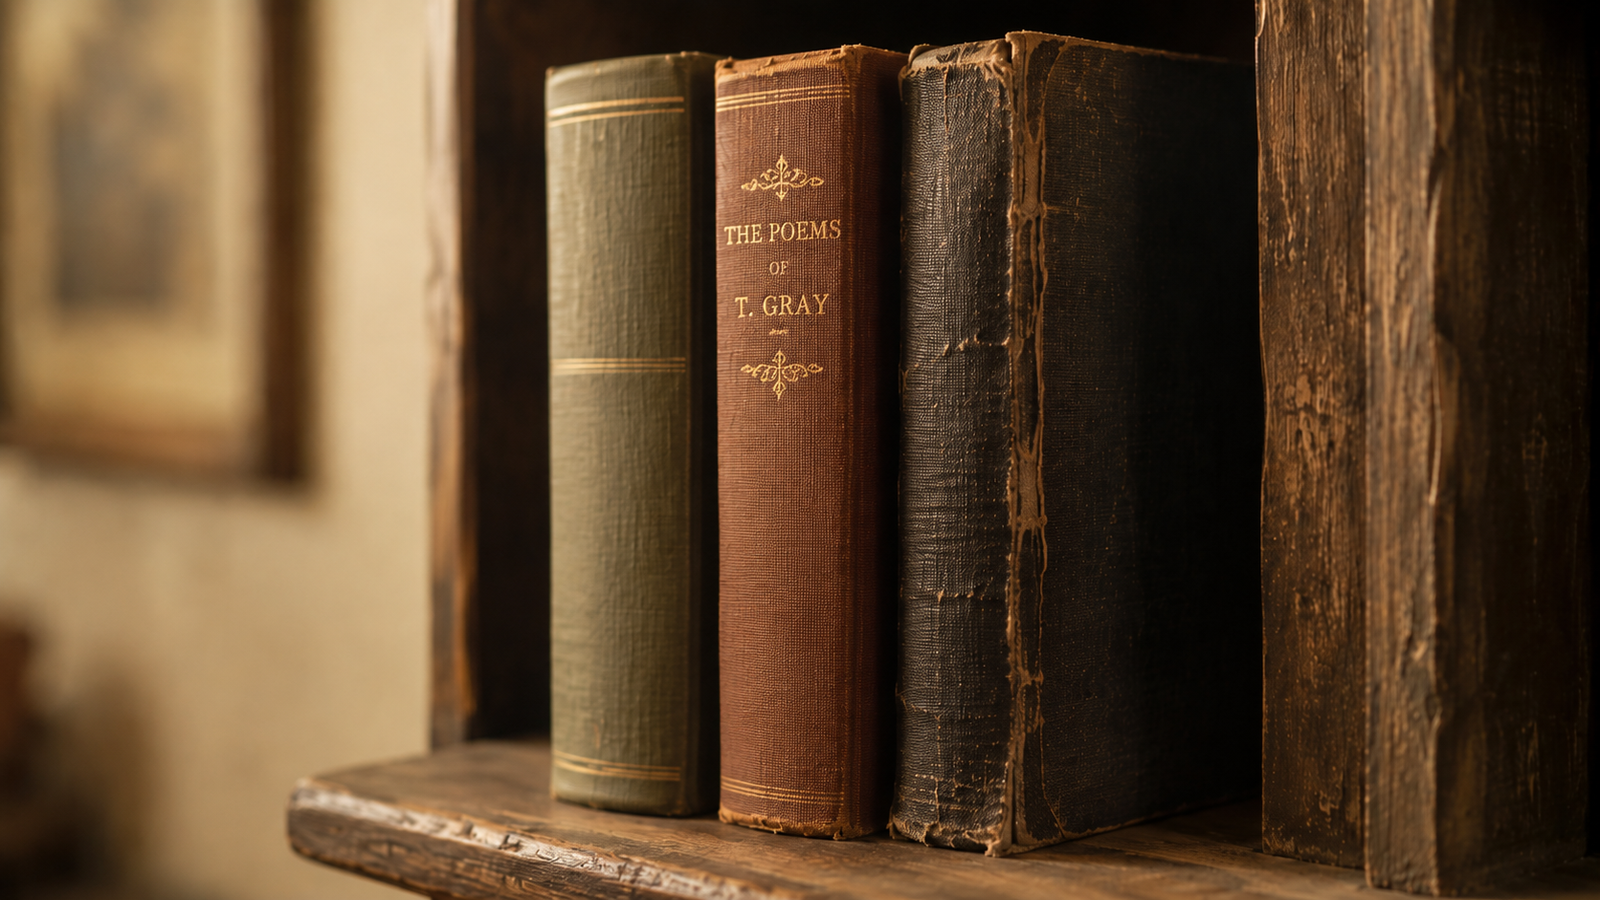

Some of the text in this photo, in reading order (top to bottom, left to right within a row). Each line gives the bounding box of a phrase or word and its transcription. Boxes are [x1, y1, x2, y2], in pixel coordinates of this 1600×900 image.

[724, 219, 841, 245] THE POEMS
[769, 260, 789, 275] OF
[735, 294, 829, 318] T. GRAY
